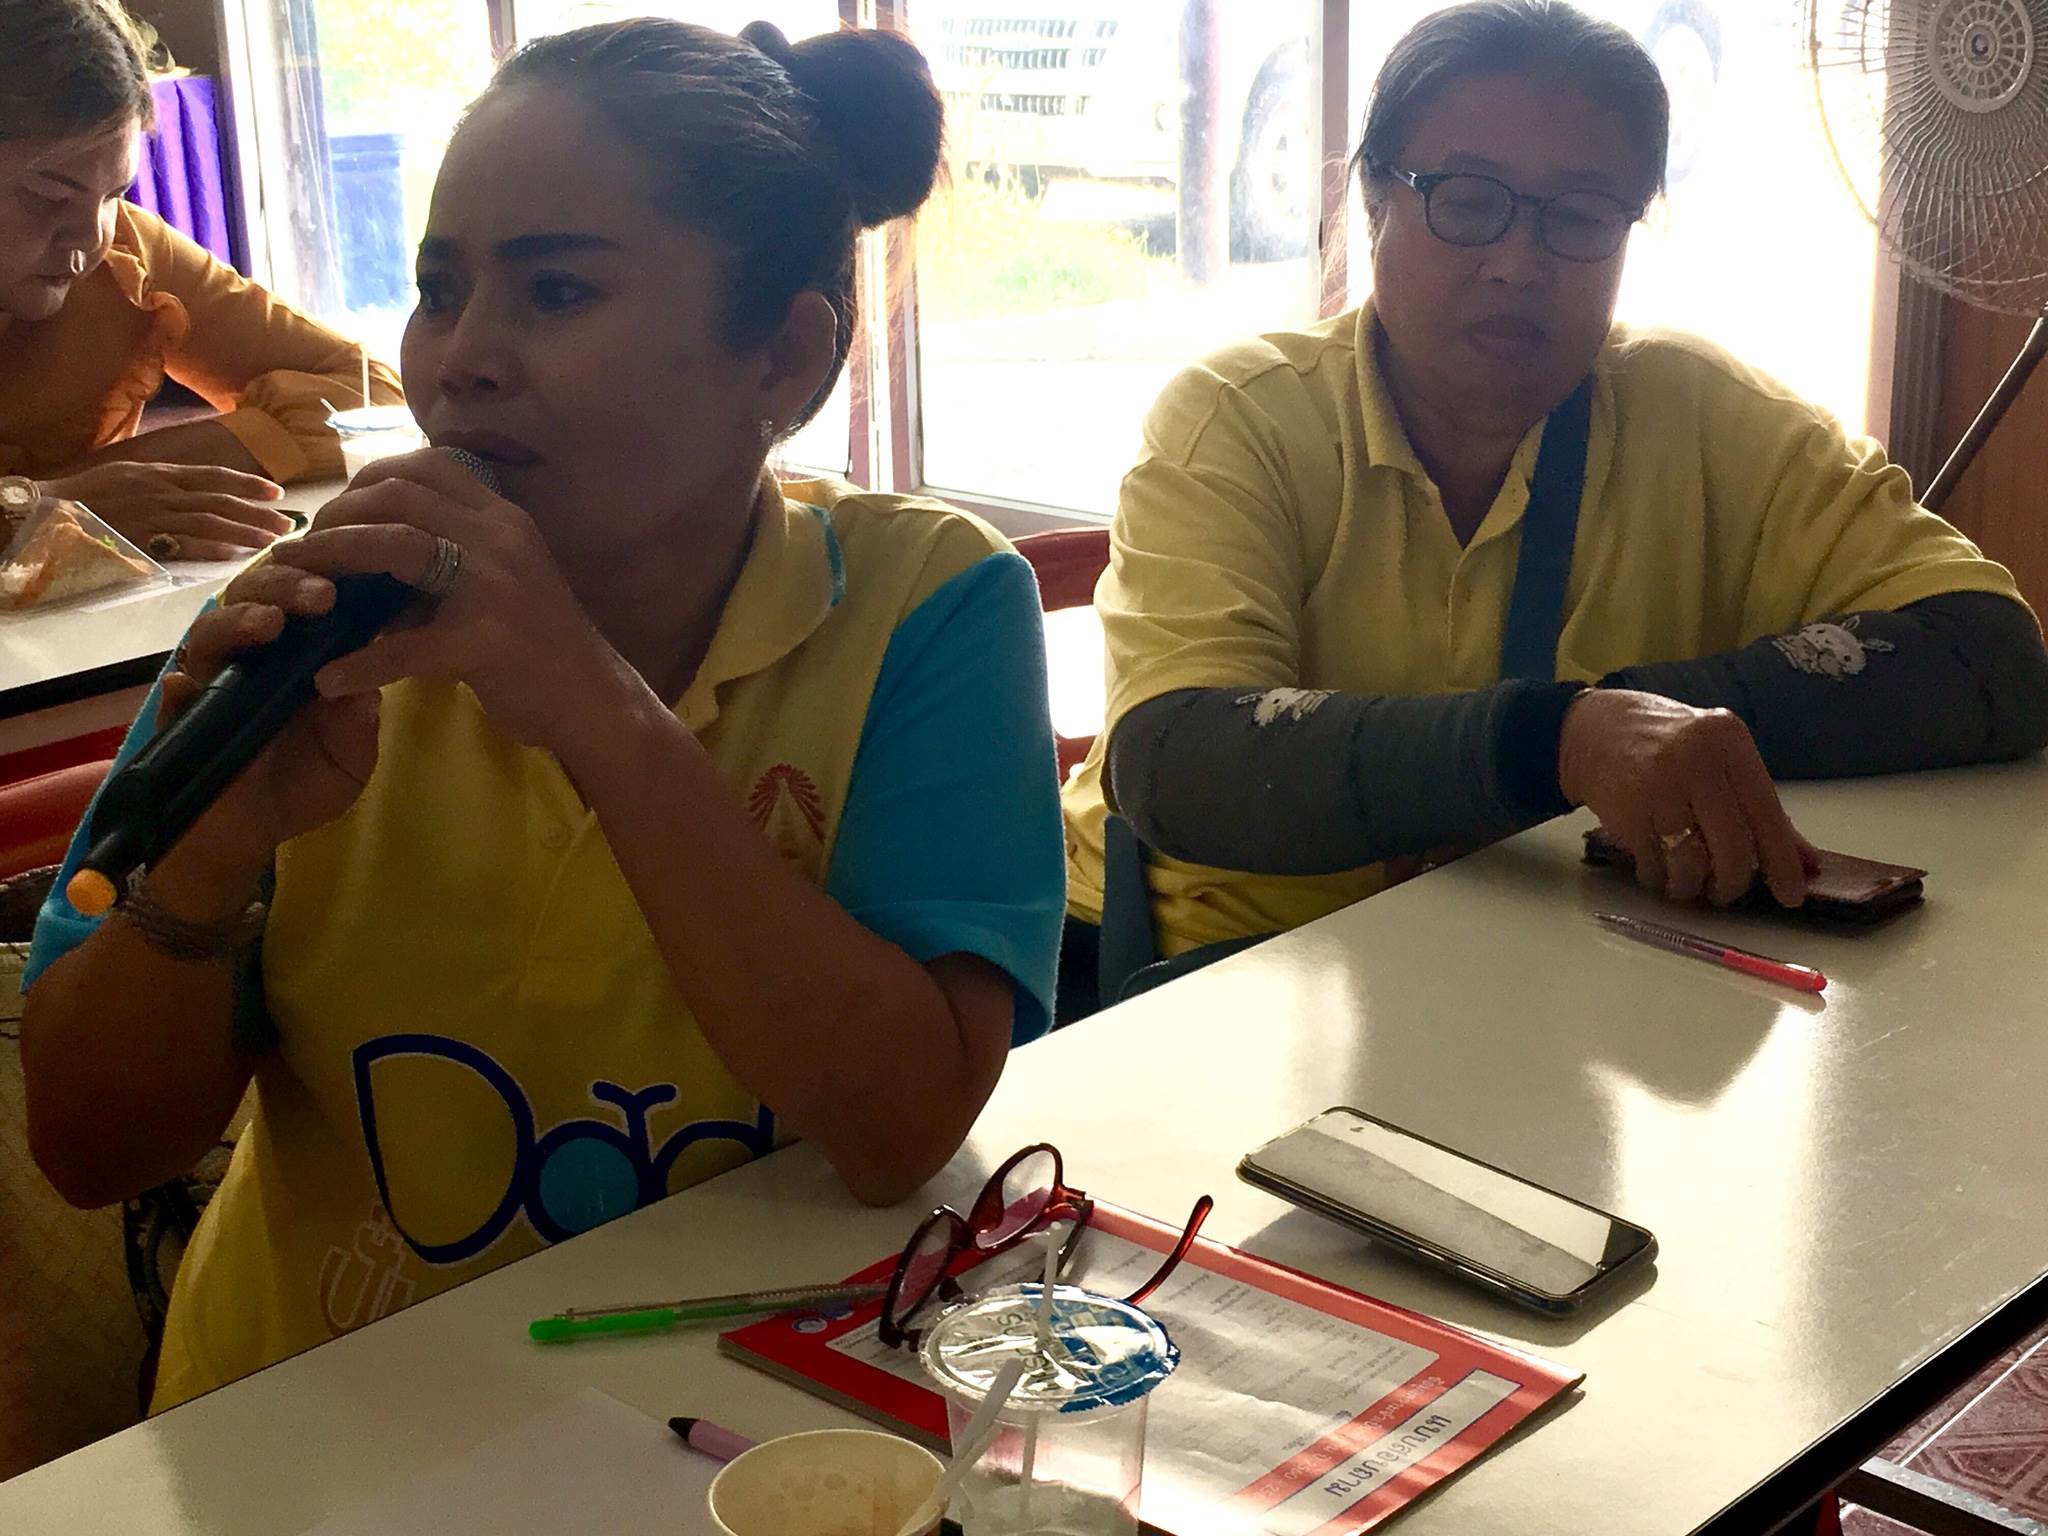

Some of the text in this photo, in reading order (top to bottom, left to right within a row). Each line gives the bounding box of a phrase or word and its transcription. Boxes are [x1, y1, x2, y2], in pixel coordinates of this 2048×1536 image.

[1284, 1459, 1316, 1480] 2560
[1323, 1415, 1451, 1497] แบบสอบถาม
